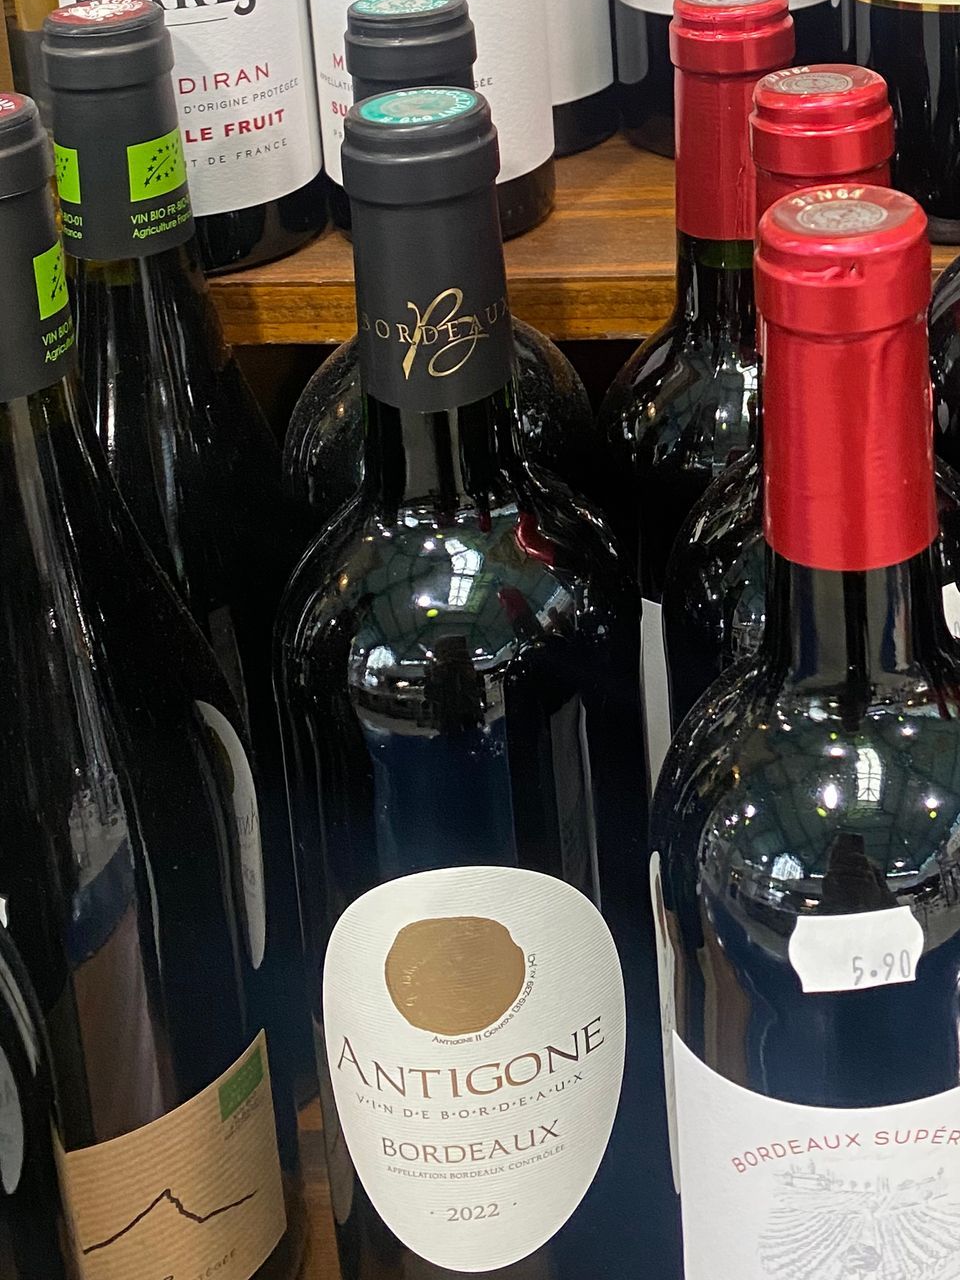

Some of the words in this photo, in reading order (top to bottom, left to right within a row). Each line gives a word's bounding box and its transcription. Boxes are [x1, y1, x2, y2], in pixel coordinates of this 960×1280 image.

[183, 96, 249, 115] D'ORIGINE
[252, 77, 299, 101] PROTÉGÉE
[224, 108, 285, 138] FRUIT
[208, 155, 226, 166] DE
[236, 138, 288, 159] FRANCE
[130, 210, 149, 226] VIN
[149, 207, 166, 222] BIO
[132, 220, 177, 240] Agriculture
[41, 328, 58, 348] VIN
[851, 948, 912, 987] 5.90
[337, 1015, 605, 1100] ANTIGONE
[381, 1118, 561, 1164] BORDEAUX
[730, 1132, 861, 1174] BORDEAUX
[386, 1165, 447, 1180] APPELLATION
[449, 1165, 505, 1180] BORDEAUX
[508, 1143, 566, 1171] CONTRÔLÉE
[446, 1202, 500, 1223] 2022
